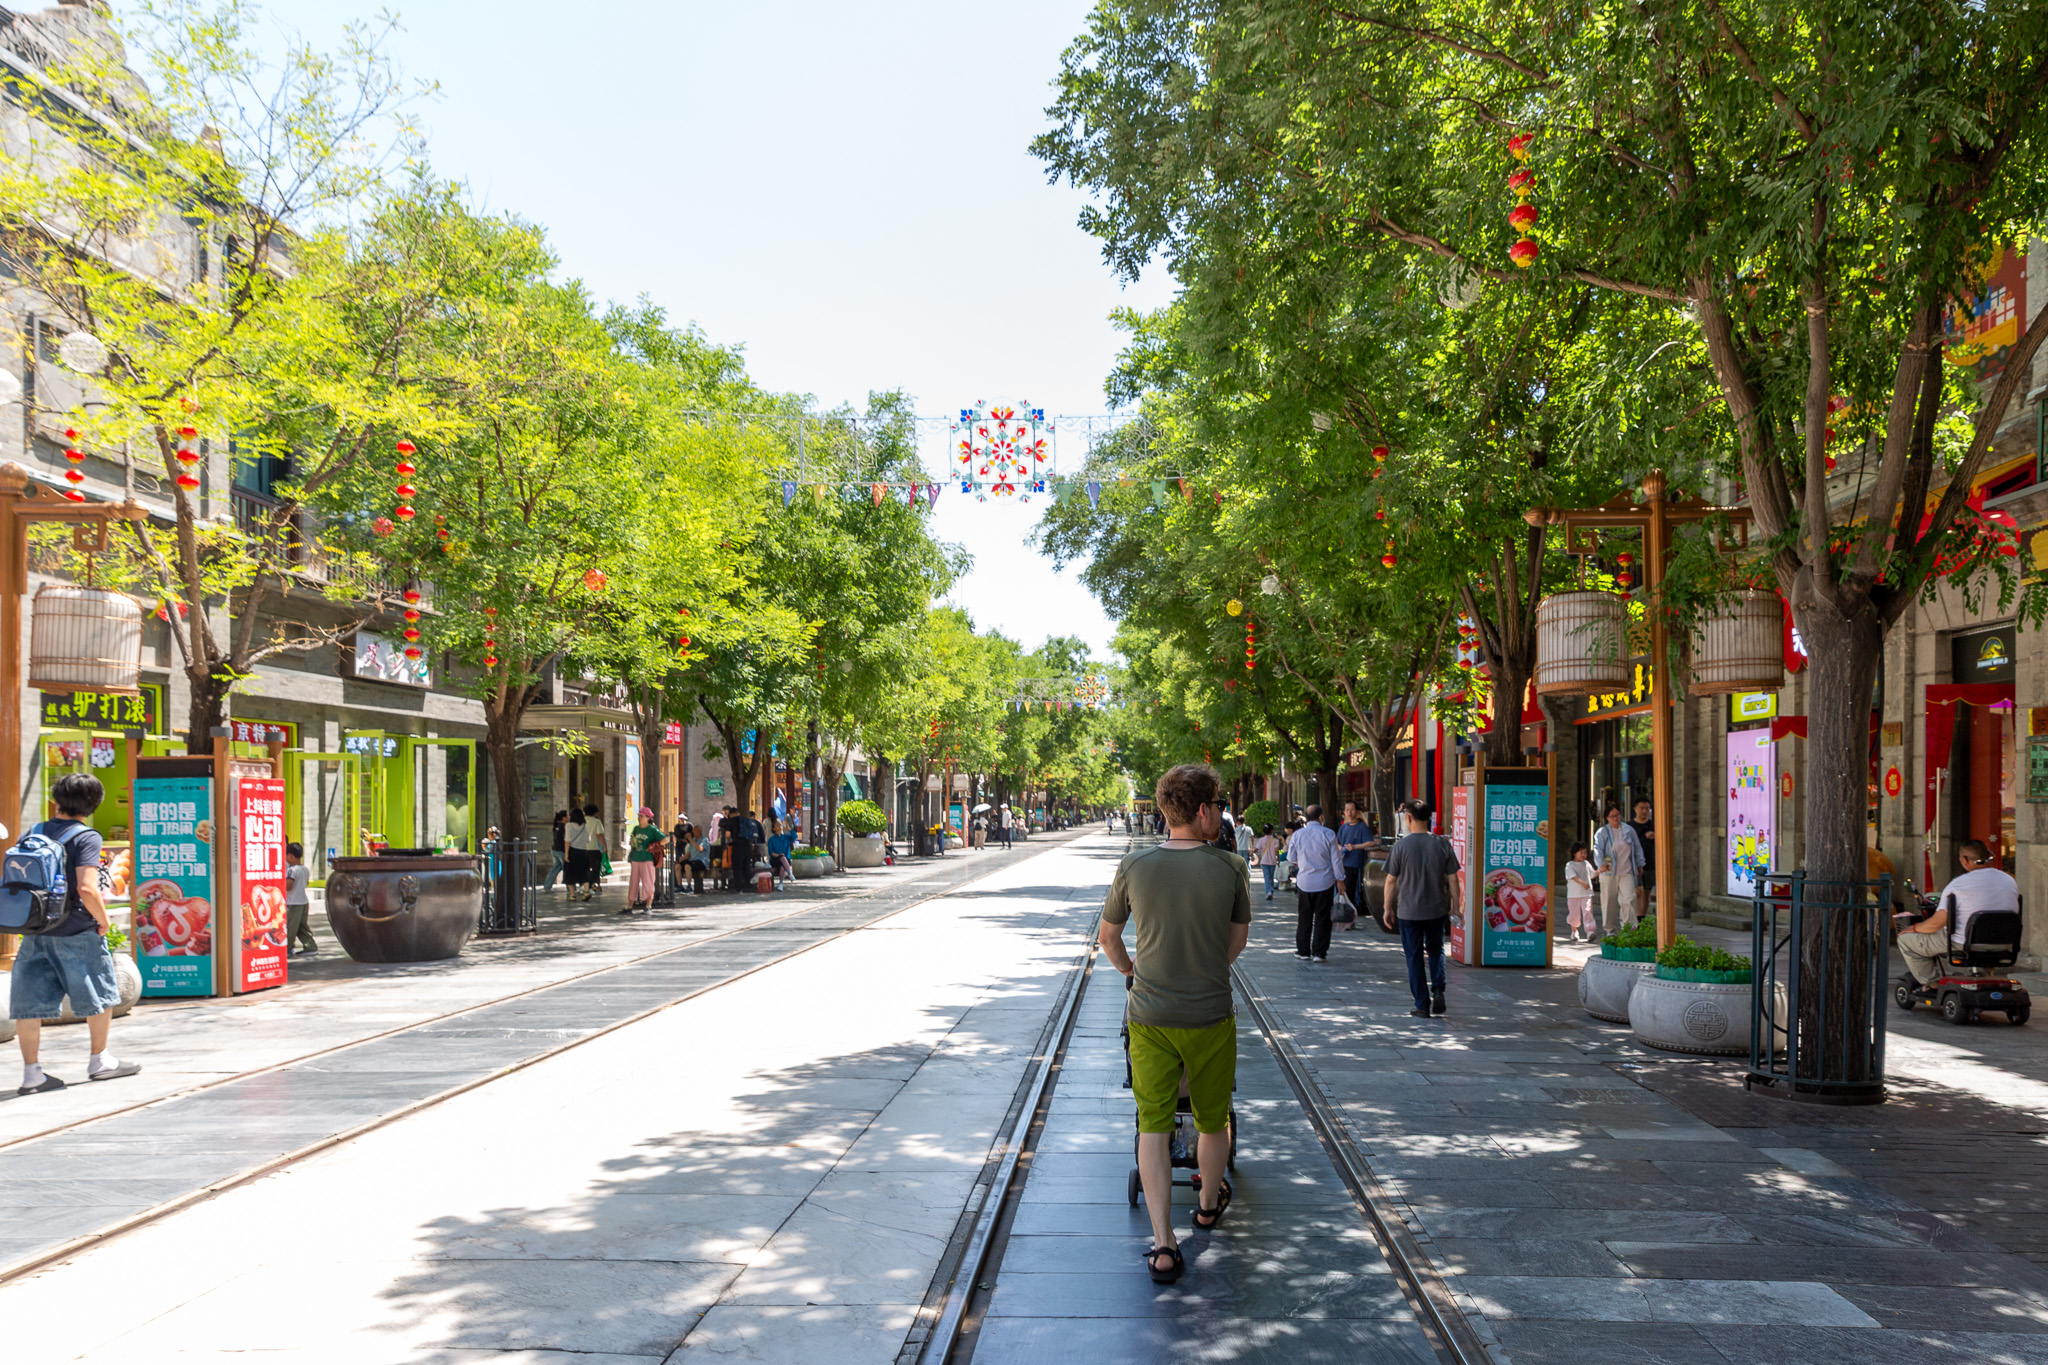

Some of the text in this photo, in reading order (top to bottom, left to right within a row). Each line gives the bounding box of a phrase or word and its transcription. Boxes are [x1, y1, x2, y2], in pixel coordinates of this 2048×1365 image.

[73, 691, 147, 723] 驴打滚
[1736, 765, 1763, 777] FLOWER
[1738, 776, 1762, 788] POWER
[139, 802, 197, 821] 趣的是
[243, 797, 283, 815] 上抖音搜
[1490, 804, 1538, 821] 趣的是
[139, 822, 194, 835] 前门热闹
[245, 815, 283, 843] 心动
[1490, 821, 1535, 832] 前门热闹
[140, 843, 198, 863] 吃的是
[1490, 838, 1537, 855] 吃的是
[245, 843, 283, 871] 前门
[1489, 855, 1545, 867] 老字号门道
[140, 863, 207, 877] 老字号门道
